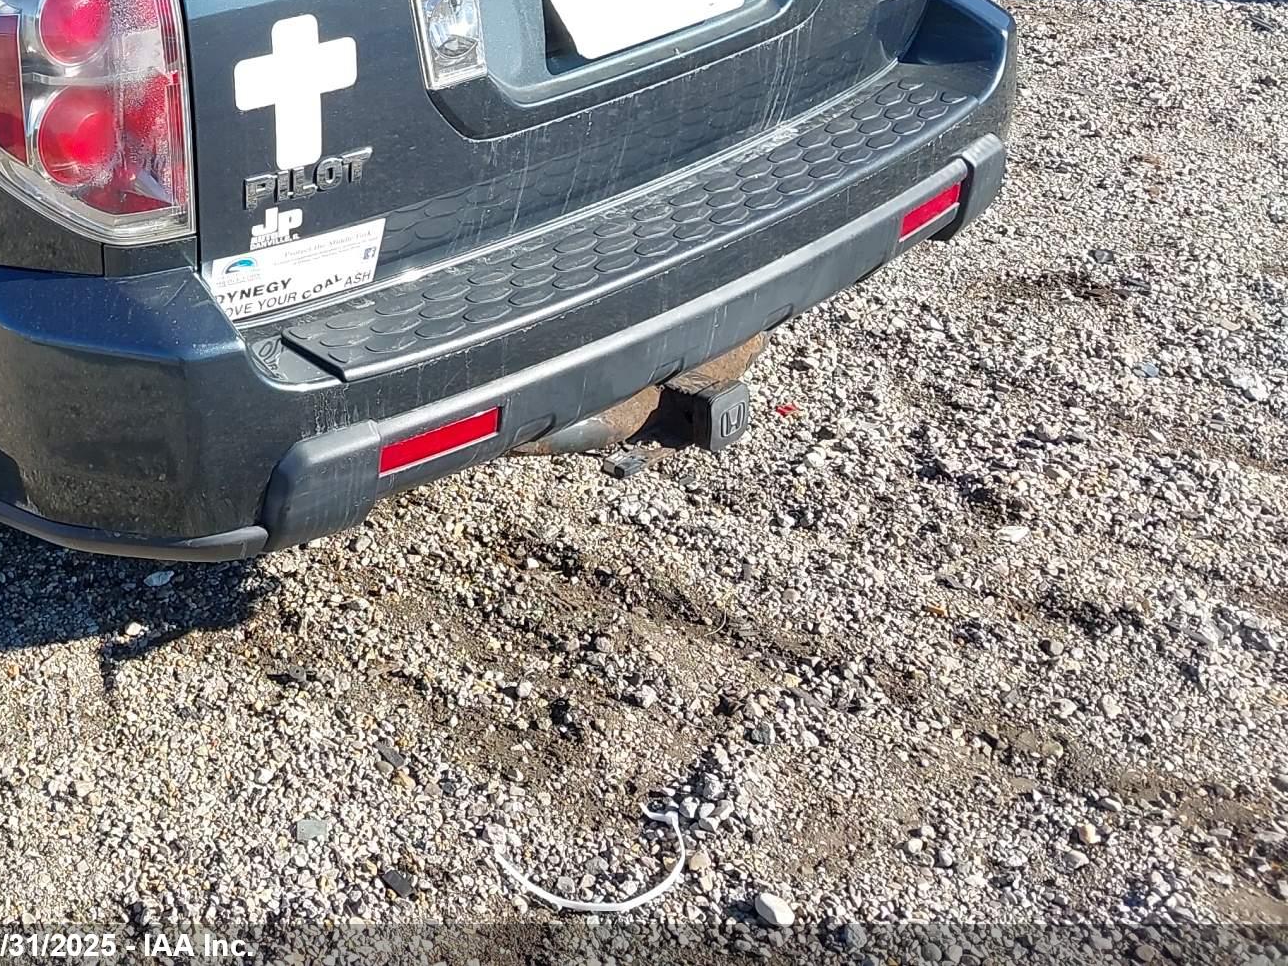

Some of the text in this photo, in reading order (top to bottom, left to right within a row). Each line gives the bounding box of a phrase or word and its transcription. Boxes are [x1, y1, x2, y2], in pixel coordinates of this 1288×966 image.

[243, 147, 373, 210] PILOT
[252, 207, 303, 237] JP
[216, 278, 292, 304] DYNEGY
[258, 292, 297, 310] YOUR
[302, 274, 342, 299] COAL
[344, 270, 371, 287] ASH
